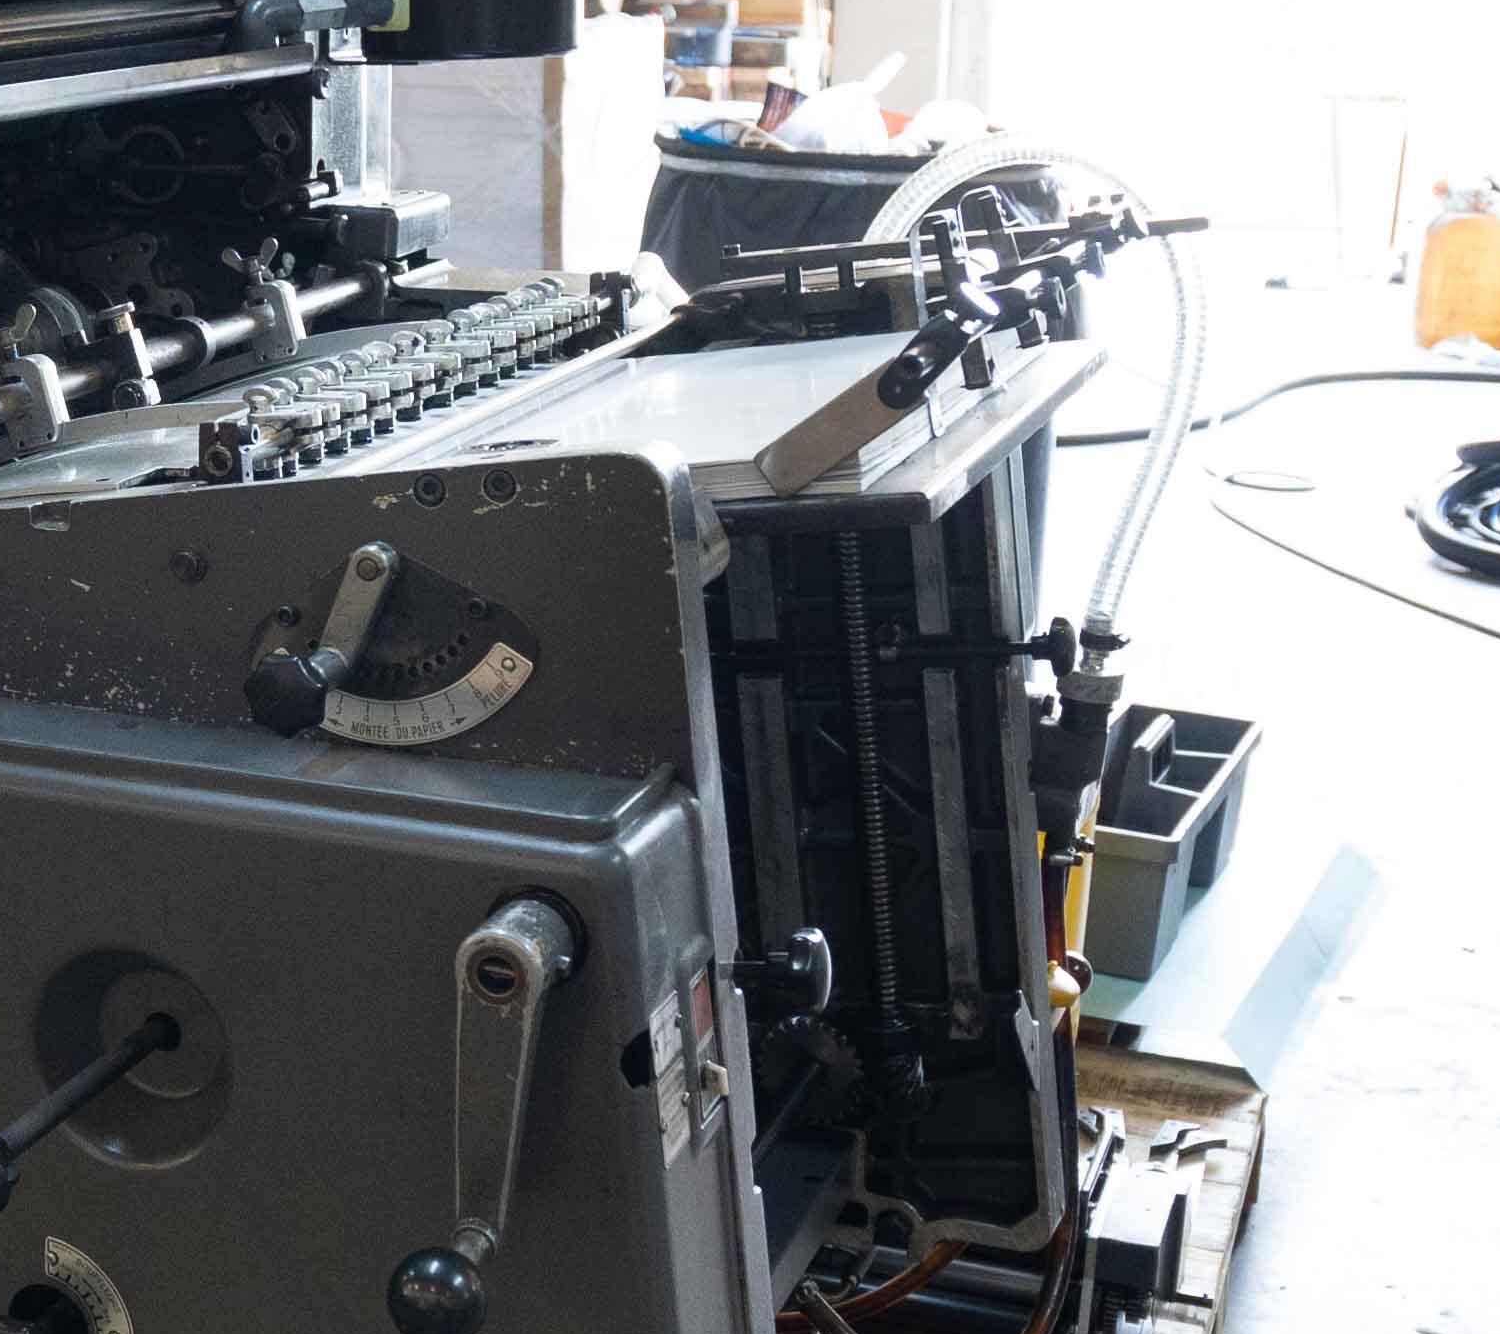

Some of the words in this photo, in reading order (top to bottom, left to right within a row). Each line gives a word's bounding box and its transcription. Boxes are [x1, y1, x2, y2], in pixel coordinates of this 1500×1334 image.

[481, 680, 513, 710] PELURE
[395, 726, 409, 740] DU
[410, 721, 446, 739] PAPIER
